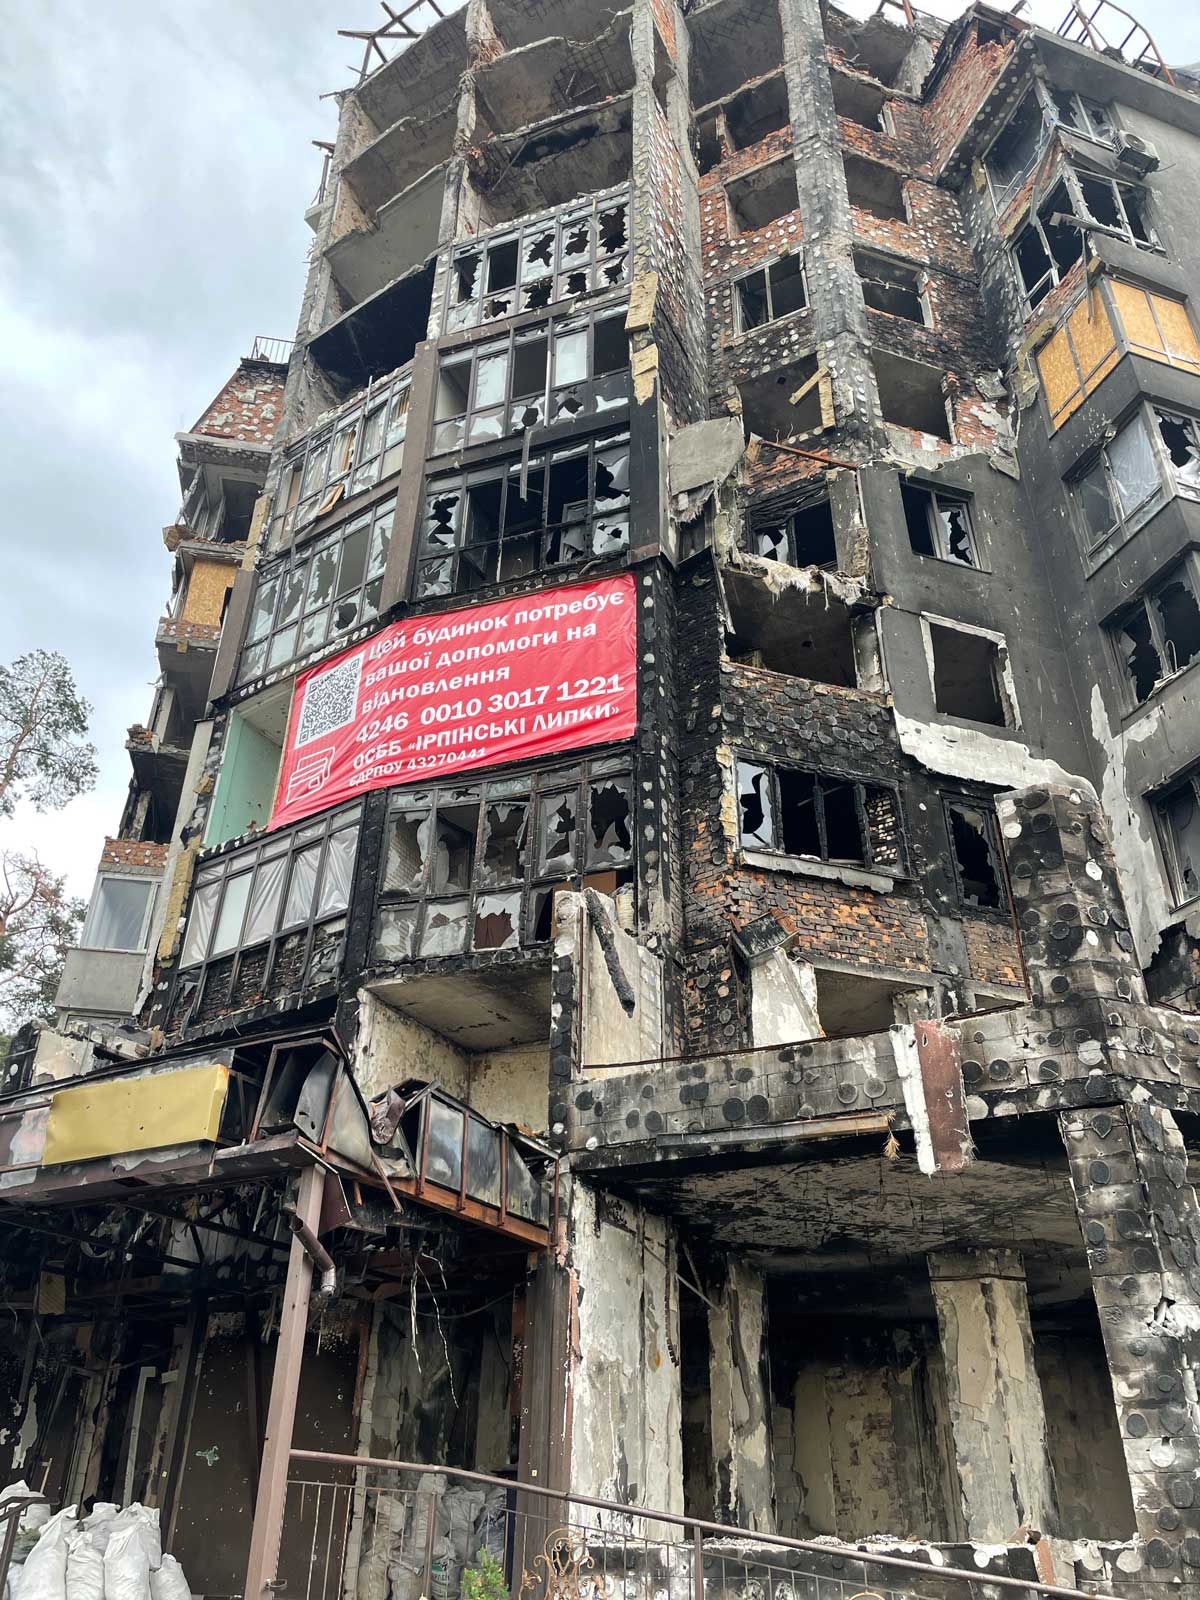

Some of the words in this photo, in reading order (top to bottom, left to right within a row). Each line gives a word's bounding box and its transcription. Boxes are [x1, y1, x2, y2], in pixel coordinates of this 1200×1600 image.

[365, 651, 432, 688] вашої
[435, 630, 558, 669] допомоги
[566, 623, 597, 641] на
[369, 630, 406, 661] Цей
[412, 614, 509, 646] будинок
[514, 591, 625, 624] потребує
[355, 711, 409, 743] 4246
[420, 698, 482, 725] 0010
[487, 685, 550, 711] 3017
[556, 673, 625, 702] 1221
[361, 666, 510, 715] відновлення
[353, 739, 402, 770] ОСББ
[408, 717, 526, 751] «ІРПІНСЬКІ
[532, 702, 620, 733] ЛИПКИ»
[407, 747, 486, 770] 43270441
